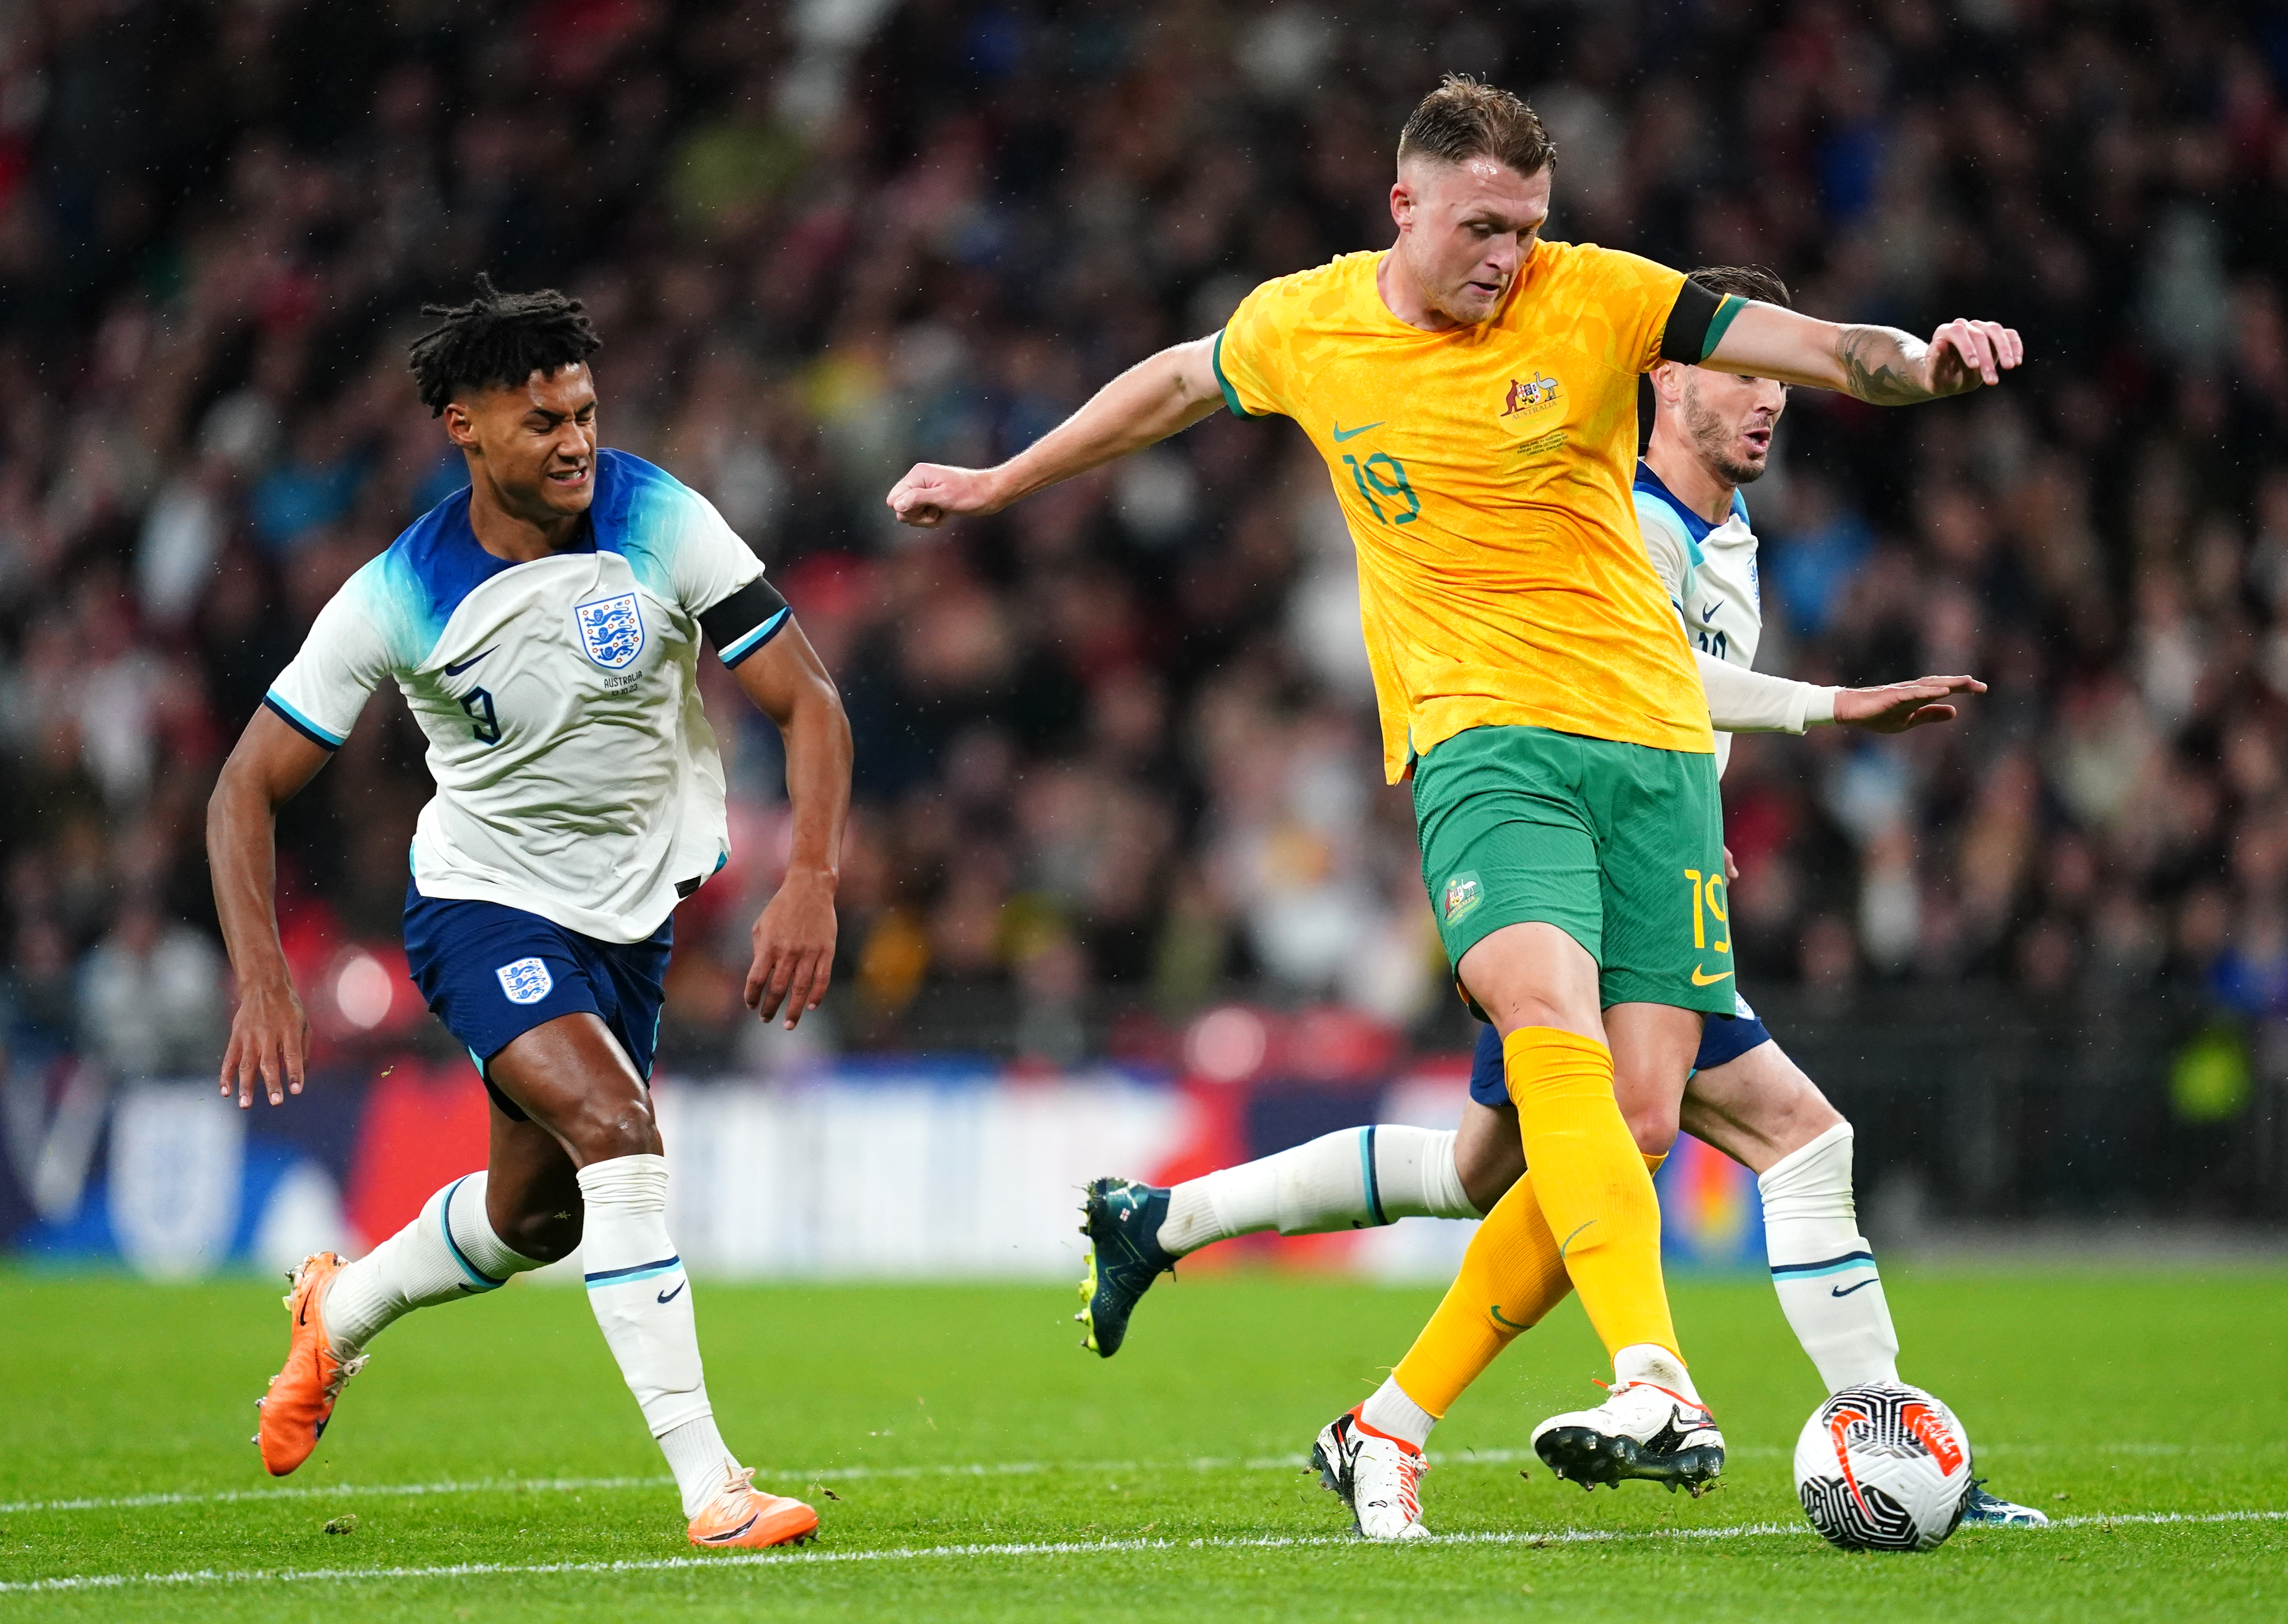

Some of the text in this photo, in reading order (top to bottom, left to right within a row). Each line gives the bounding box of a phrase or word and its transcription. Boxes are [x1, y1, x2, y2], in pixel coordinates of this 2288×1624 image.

[1513, 401, 1557, 420] AUSTRALIA
[1520, 440, 1538, 449] ENGLAND
[1543, 438, 1561, 446] OCTOBER
[1343, 453, 1420, 525] 19
[460, 686, 501, 745] 9
[1685, 870, 1730, 953] 19
